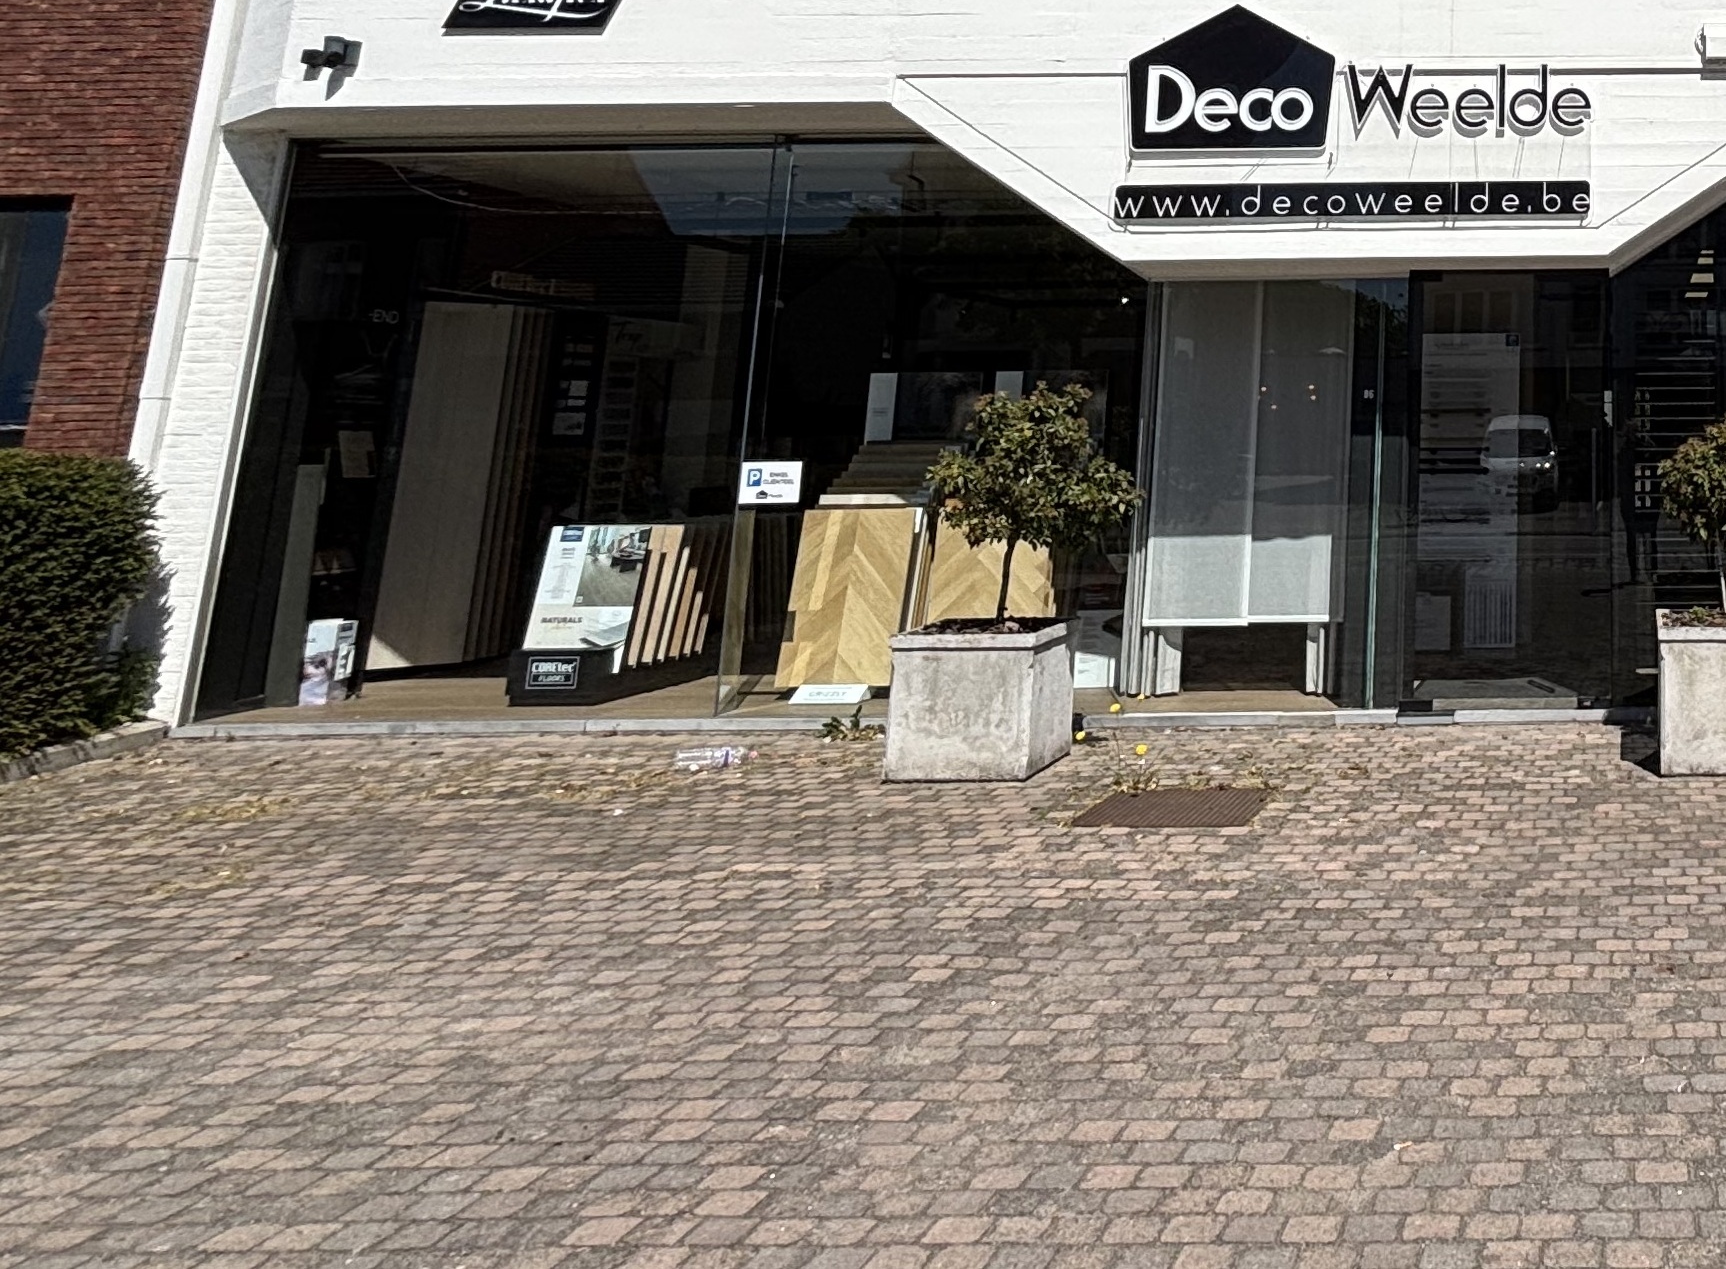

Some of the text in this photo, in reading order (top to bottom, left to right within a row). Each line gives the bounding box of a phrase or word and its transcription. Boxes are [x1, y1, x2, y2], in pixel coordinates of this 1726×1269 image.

[1145, 63, 1592, 133] Deco Weelde
[1114, 181, 1591, 219] www.decoweelde.be
